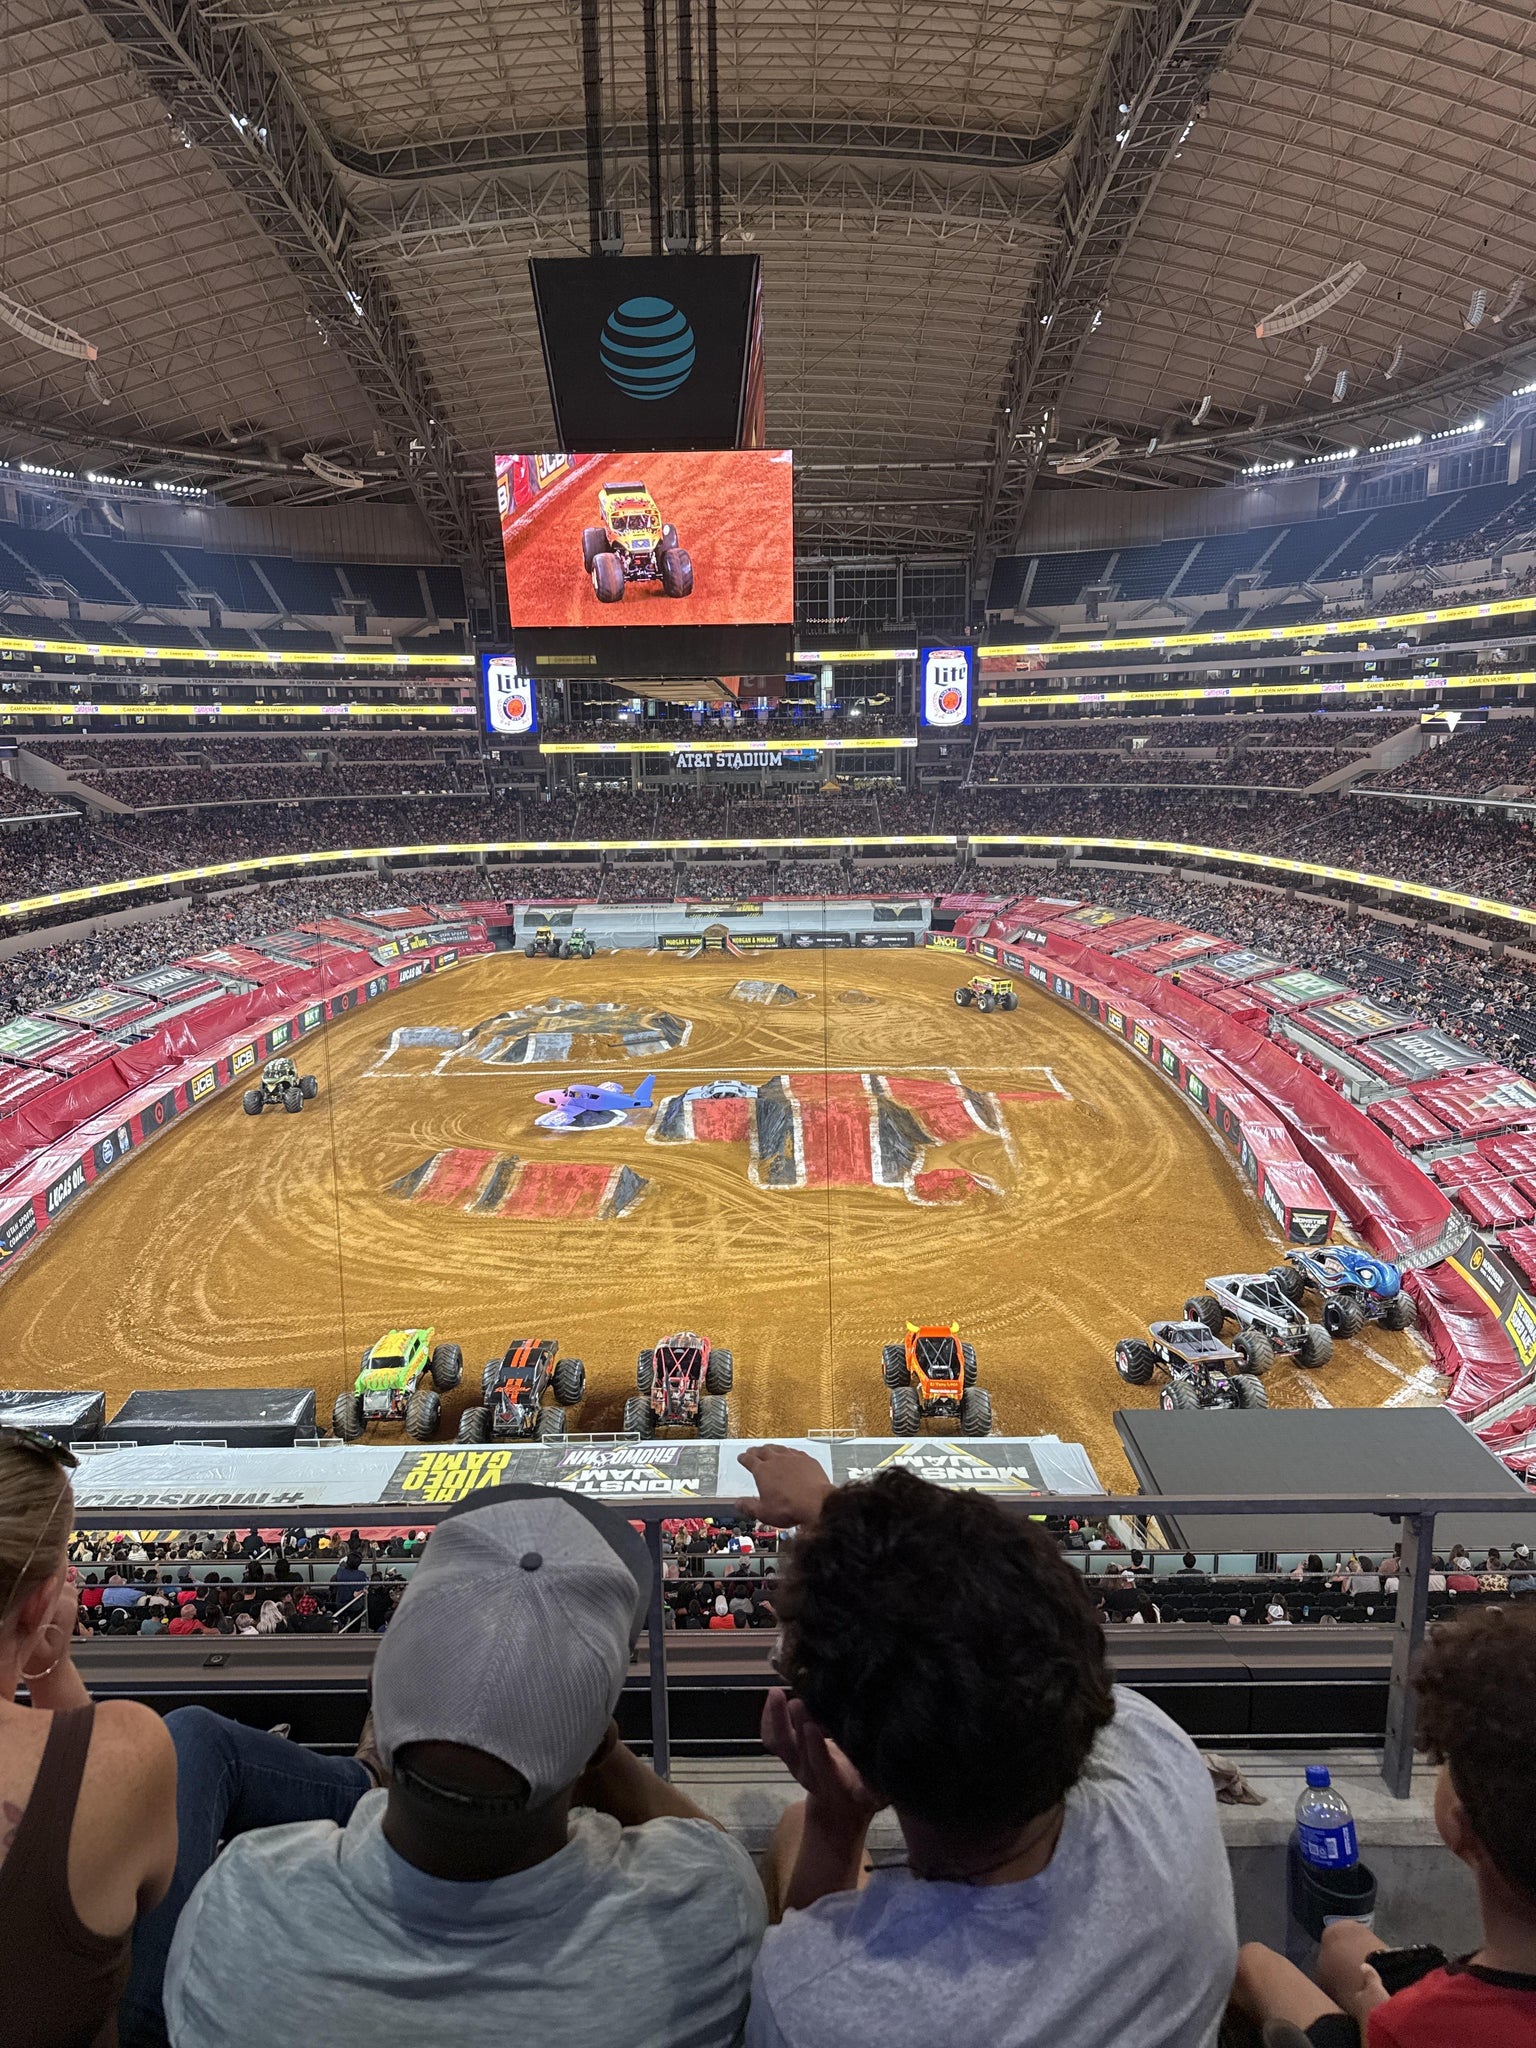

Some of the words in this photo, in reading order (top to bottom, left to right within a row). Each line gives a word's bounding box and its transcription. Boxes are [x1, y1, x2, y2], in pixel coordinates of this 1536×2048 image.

[934, 666, 966, 686] Lite
[676, 753, 714, 768] AT&T
[716, 752, 782, 768] STADIUM
[933, 936, 958, 947] UNOH
[272, 1027, 288, 1046] BKT
[234, 1051, 253, 1069] JCB
[193, 1074, 213, 1095] JCB
[48, 1174, 72, 1212] LUCAS
[72, 1165, 86, 1189] OIL
[6, 1222, 19, 1238] UTAH
[18, 1207, 34, 1227] SPORTS
[1292, 1217, 1327, 1225] MONSTER
[9, 1217, 36, 1248] COMMISSION
[416, 1451, 513, 1471] GAME
[893, 1455, 974, 1467] JAM
[402, 1469, 502, 1491] VIDEO
[578, 1469, 654, 1480] JAM
[845, 1466, 1030, 1479] MONSR
